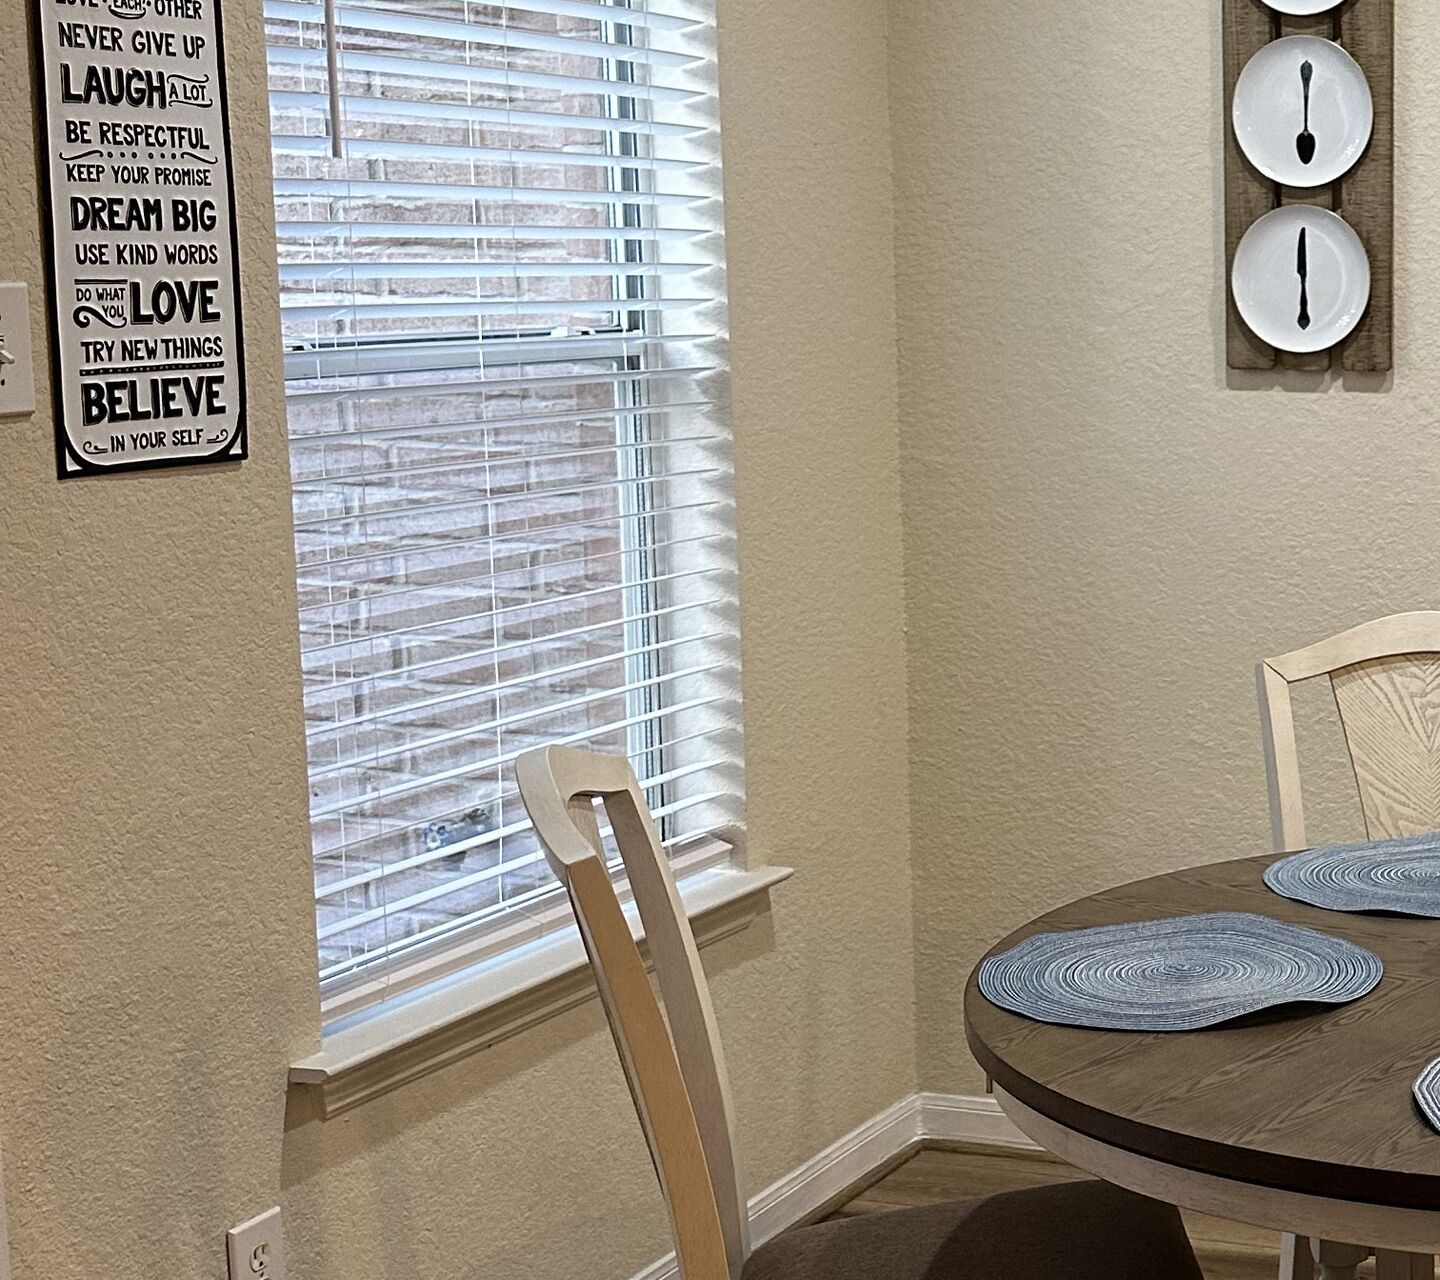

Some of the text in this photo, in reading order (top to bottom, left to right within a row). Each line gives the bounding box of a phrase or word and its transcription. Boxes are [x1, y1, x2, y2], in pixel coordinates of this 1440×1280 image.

[58, 22, 206, 59] NEVER GIVE UP
[59, 63, 208, 109] LAUGH A LOT
[65, 120, 210, 150] BE RESPECTFUL
[66, 164, 212, 187] KEEP YOUR PROMISE
[70, 196, 217, 232] DREAM BIG
[75, 244, 218, 265] USE KIND WORDS
[76, 287, 126, 302] DO WHAT
[129, 280, 221, 325] LOVE
[102, 305, 125, 319] YOU
[80, 336, 223, 363] TRY NEW THINGS
[80, 375, 226, 426] BELIEVE
[110, 428, 204, 452] IN YOUR SELF
